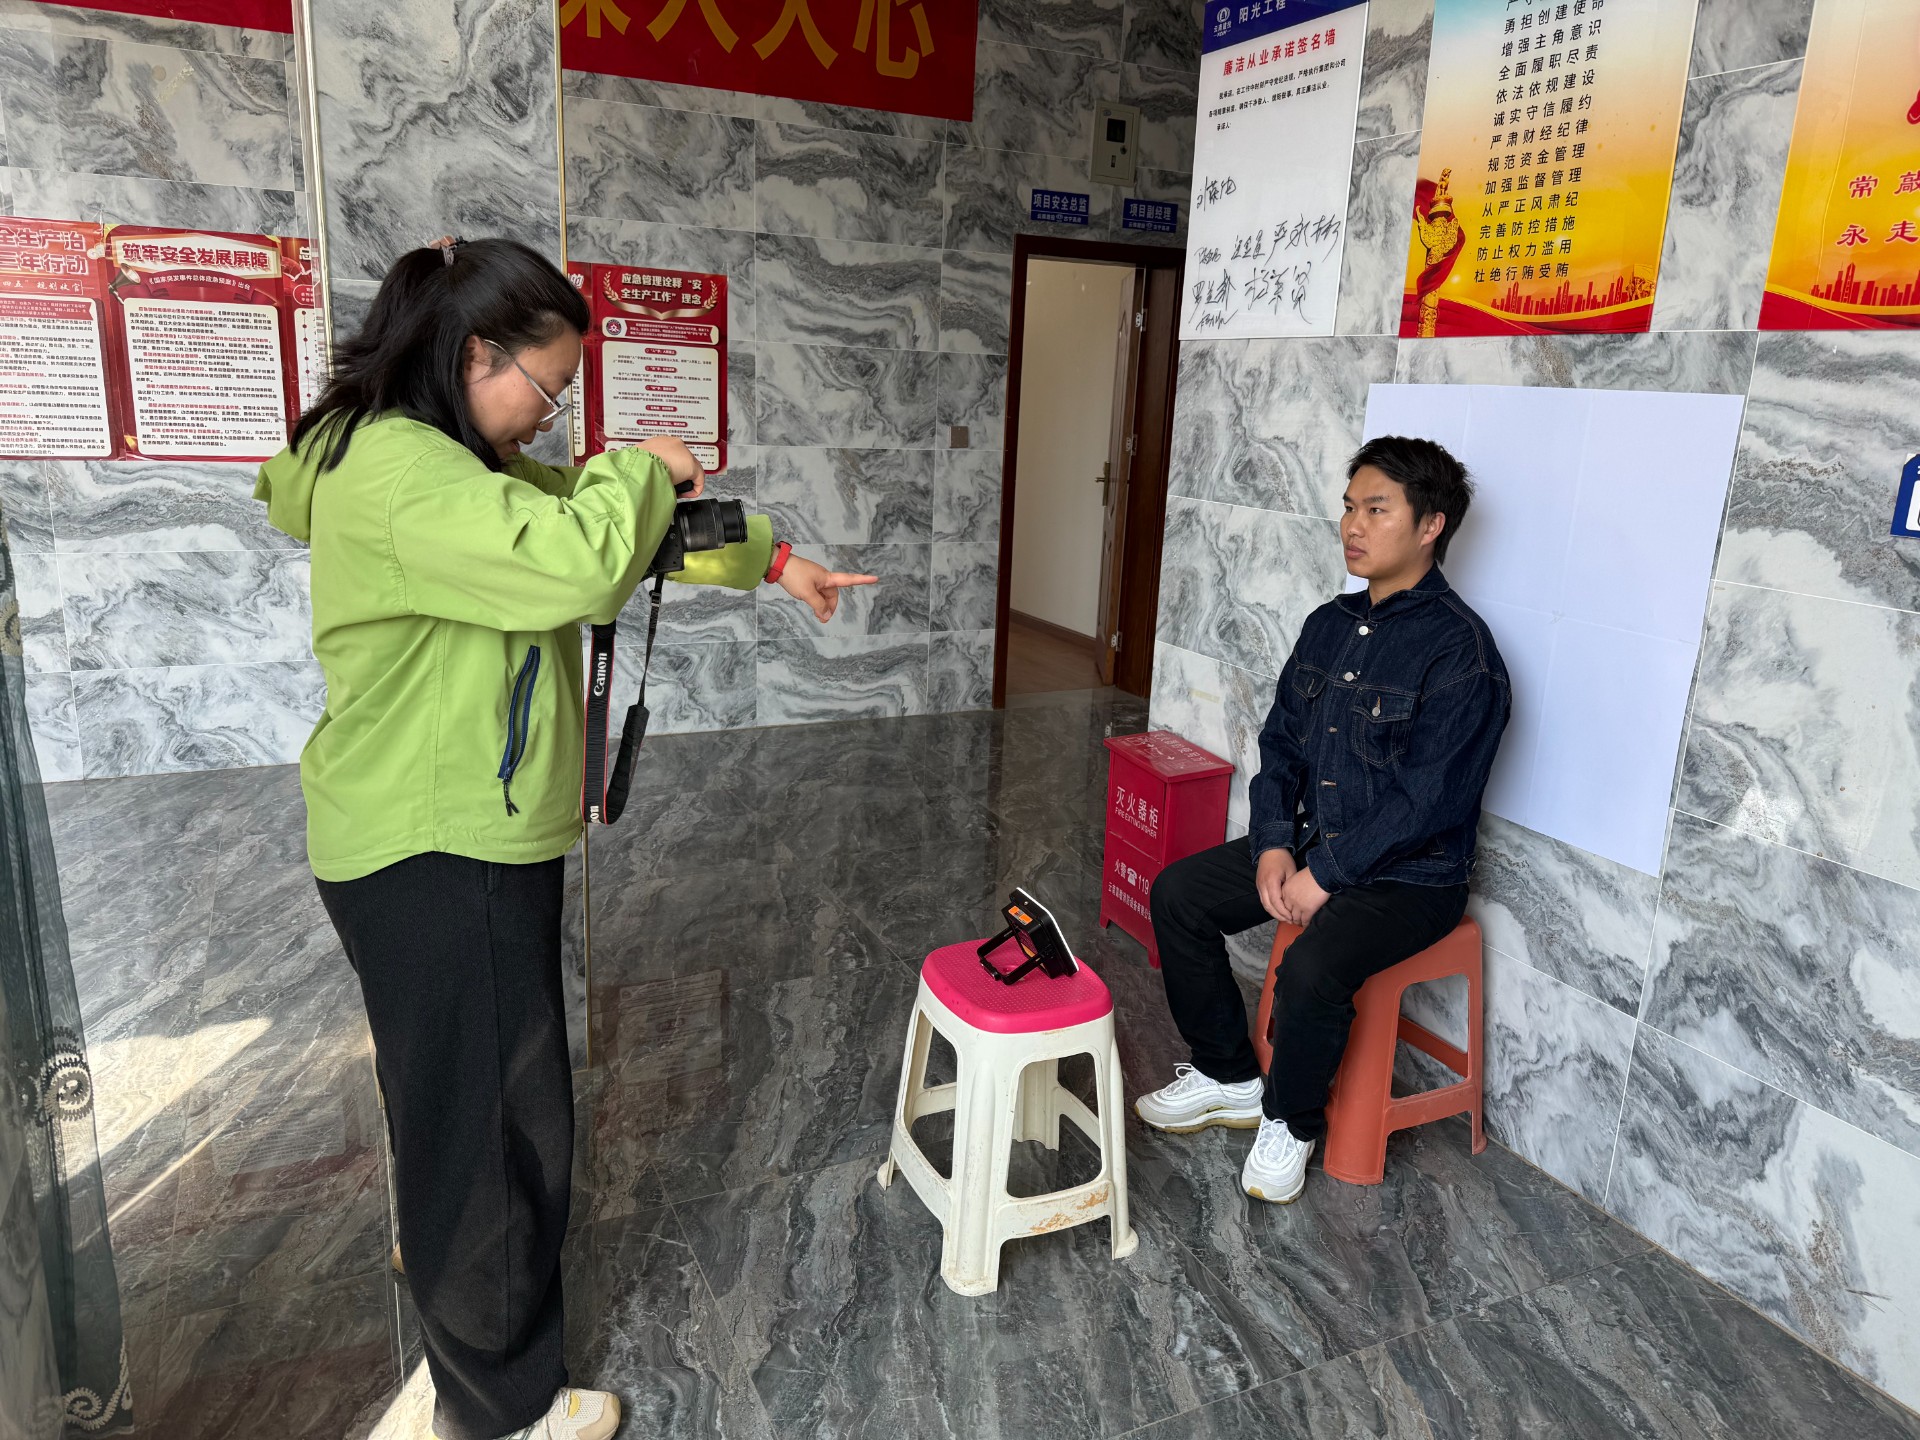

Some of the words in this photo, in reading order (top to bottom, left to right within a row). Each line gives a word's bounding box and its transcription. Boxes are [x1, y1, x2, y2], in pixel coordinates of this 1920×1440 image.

[1501, 19, 1602, 57] 增强主角意识
[1222, 28, 1336, 77] 廉洁从业承诺签名墙
[1498, 44, 1599, 81] 全面履职尽责
[1496, 69, 1596, 104] 依法依规建设
[1493, 94, 1592, 127] 诚实守信履约
[1490, 119, 1588, 149] 严肃财经纪律
[1487, 143, 1585, 172] 规范资金管理
[1484, 167, 1582, 195] 加强监督管理
[1033, 193, 1087, 212] 项目安全总监
[1129, 203, 1172, 220] 项目副经理
[1482, 191, 1579, 218] 从严正风肃纪
[1479, 215, 1575, 240] 完善防控措施
[1836, 219, 1920, 247] 永走
[121, 242, 270, 269] 筑牢安全发展屏障
[1477, 239, 1572, 262] 防止权力滥用
[1474, 262, 1569, 284] 杜绝行贿受贿
[593, 652, 608, 697] Canon
[1115, 785, 1159, 830] 灭火器柜
[1138, 874, 1150, 896] 119
